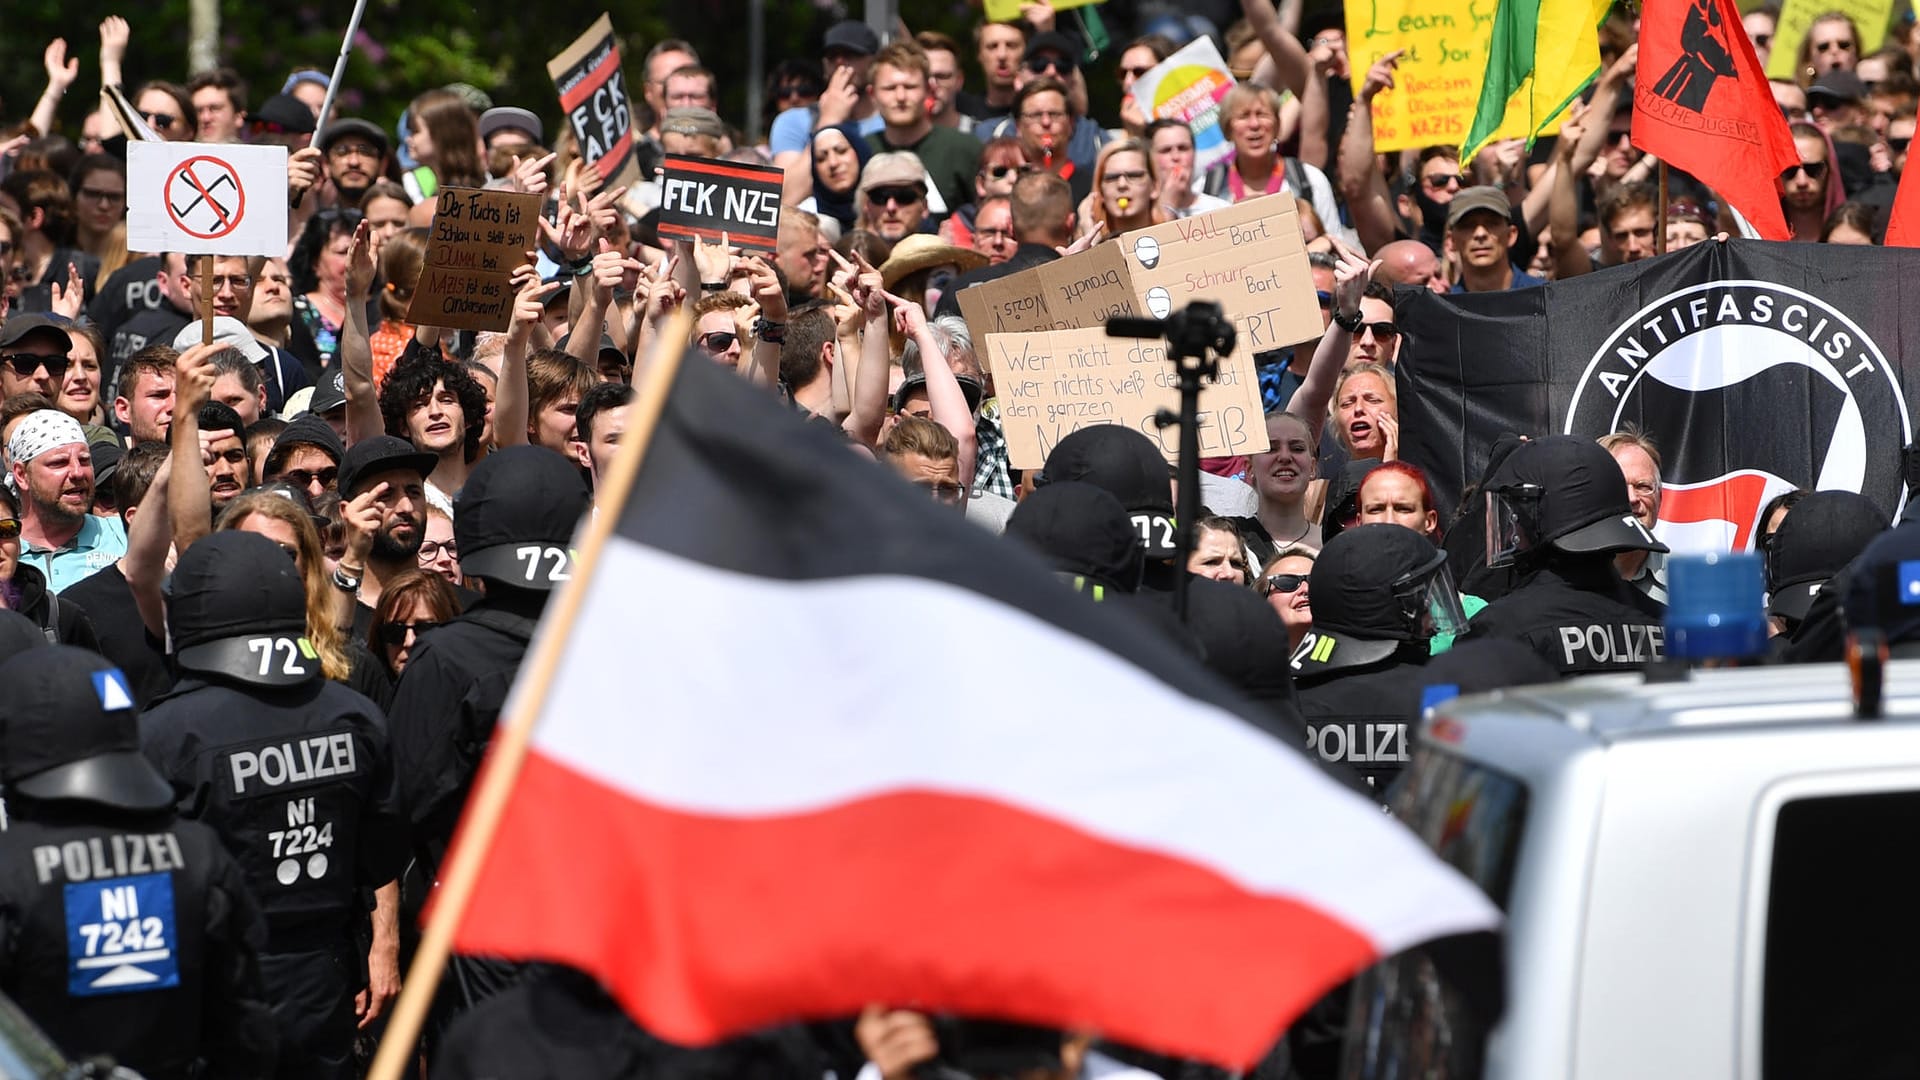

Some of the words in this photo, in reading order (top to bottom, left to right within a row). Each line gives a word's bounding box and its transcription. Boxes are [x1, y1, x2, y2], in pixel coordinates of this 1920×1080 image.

[571, 72, 624, 139] FCK
[586, 104, 629, 165] AFD
[1411, 114, 1463, 136] NAZIS
[438, 191, 464, 219] Der
[468, 193, 500, 223] Fuchs
[505, 203, 520, 224] ist
[664, 178, 718, 216] FCK
[723, 187, 779, 227] NZS
[1176, 214, 1224, 243] Voll
[1229, 219, 1270, 246] Bart
[482, 251, 498, 268] bei
[1060, 269, 1124, 304] braucht
[1185, 266, 1247, 292] Schnurr
[1245, 269, 1281, 294] Bart
[1000, 340, 1053, 372] Wer
[1068, 347, 1112, 369] nicht
[1598, 294, 1875, 399] ANTIFASCIST
[1008, 380, 1042, 398] wer
[1054, 374, 1104, 396] nichts
[1006, 401, 1038, 418] den
[1047, 400, 1113, 423] ganzen
[1130, 514, 1176, 548] 72
[516, 546, 572, 581] 72
[248, 637, 305, 675] 72
[1559, 624, 1667, 664] POLIZE
[229, 732, 356, 793] POLIZEI
[287, 797, 315, 827] NI
[268, 822, 333, 857] 7224
[32, 832, 185, 884] POLIZEI
[100, 885, 139, 921] NI
[79, 917, 165, 956] 7242
